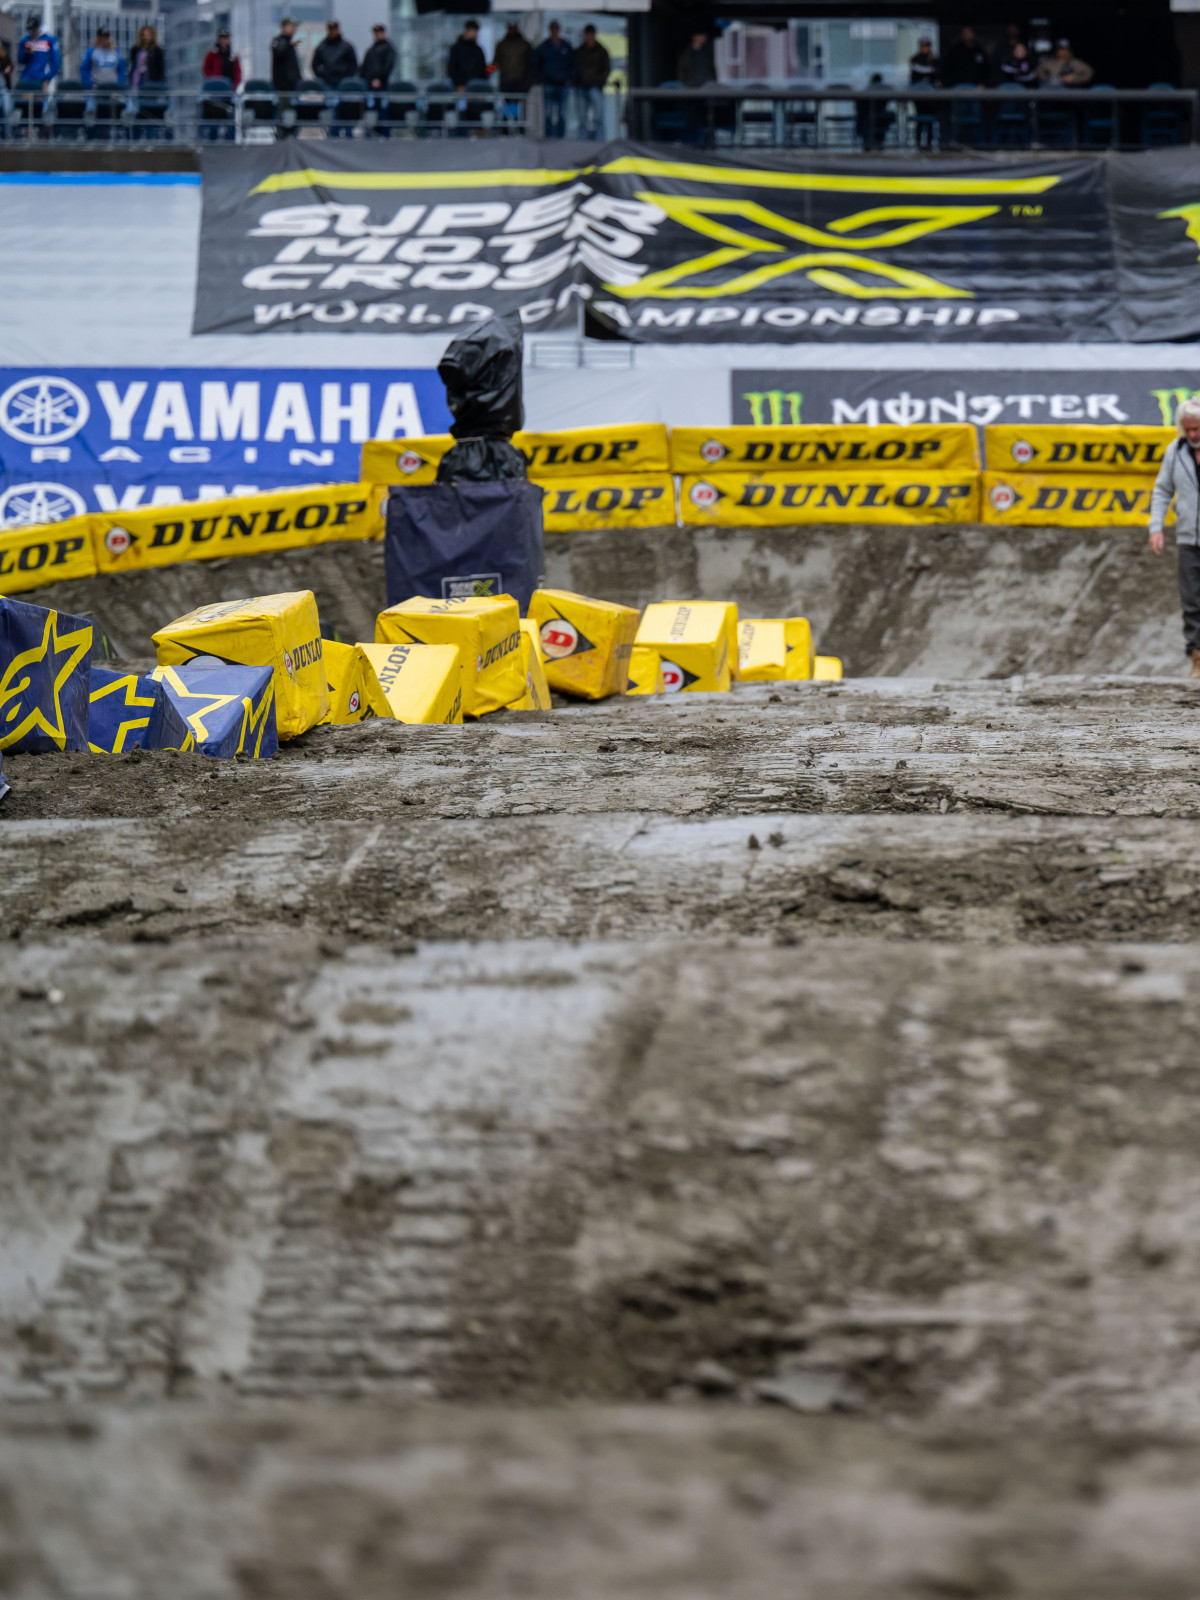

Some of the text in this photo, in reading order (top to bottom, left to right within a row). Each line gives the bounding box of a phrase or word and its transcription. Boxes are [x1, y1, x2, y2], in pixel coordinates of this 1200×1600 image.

[96, 380, 426, 444] YAMAHA
[831, 389, 1130, 428] MONSTER
[742, 439, 942, 463] DUNLOP
[735, 482, 972, 508] DUNLOP
[147, 500, 367, 549] DUNLOP
